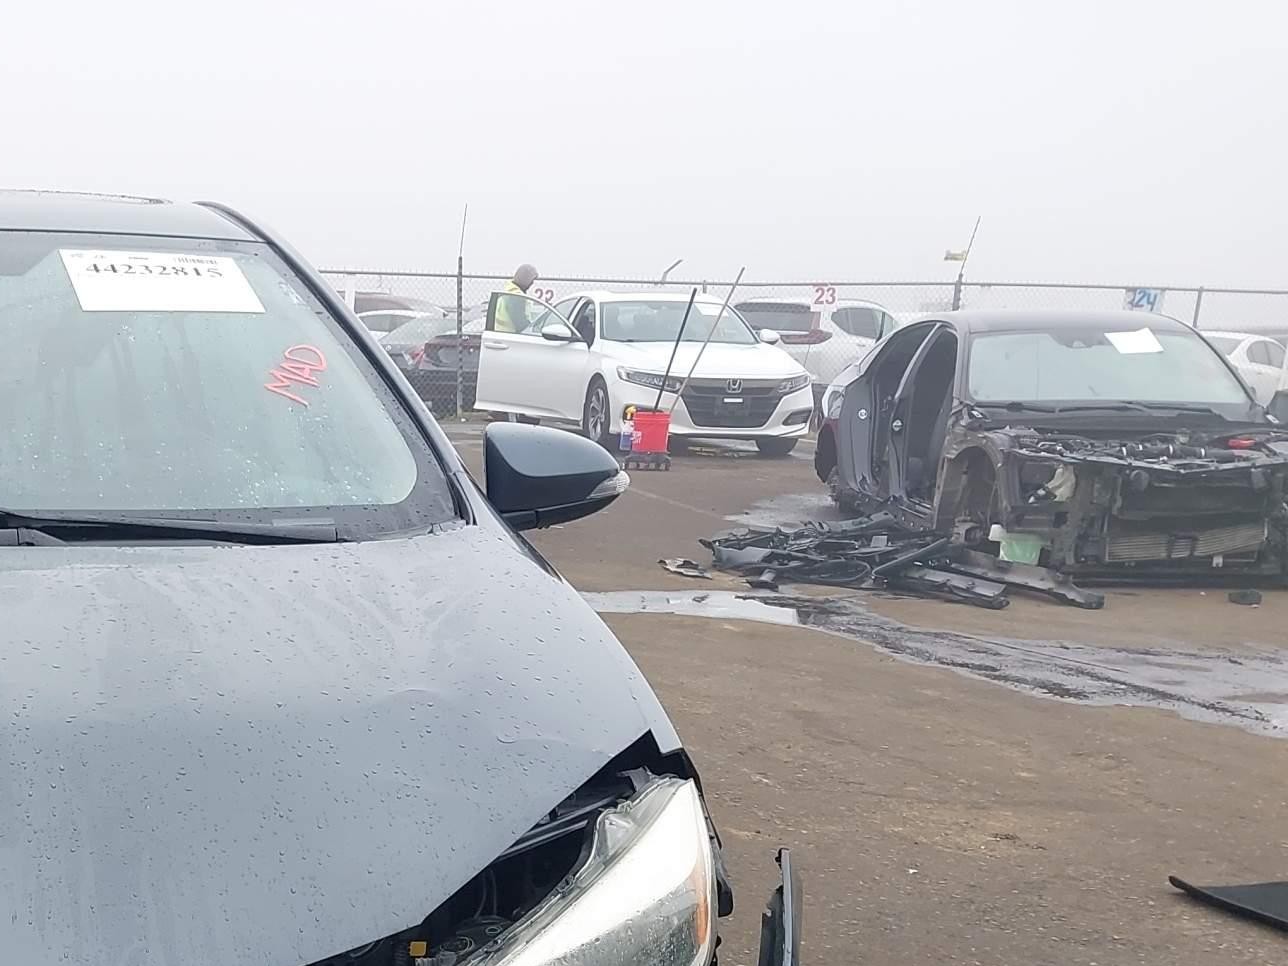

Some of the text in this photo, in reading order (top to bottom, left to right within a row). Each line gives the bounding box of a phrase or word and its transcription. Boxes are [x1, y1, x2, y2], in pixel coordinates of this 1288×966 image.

[85, 262, 224, 278] 44232815
[814, 286, 836, 305] 23
[1135, 289, 1158, 312] 24
